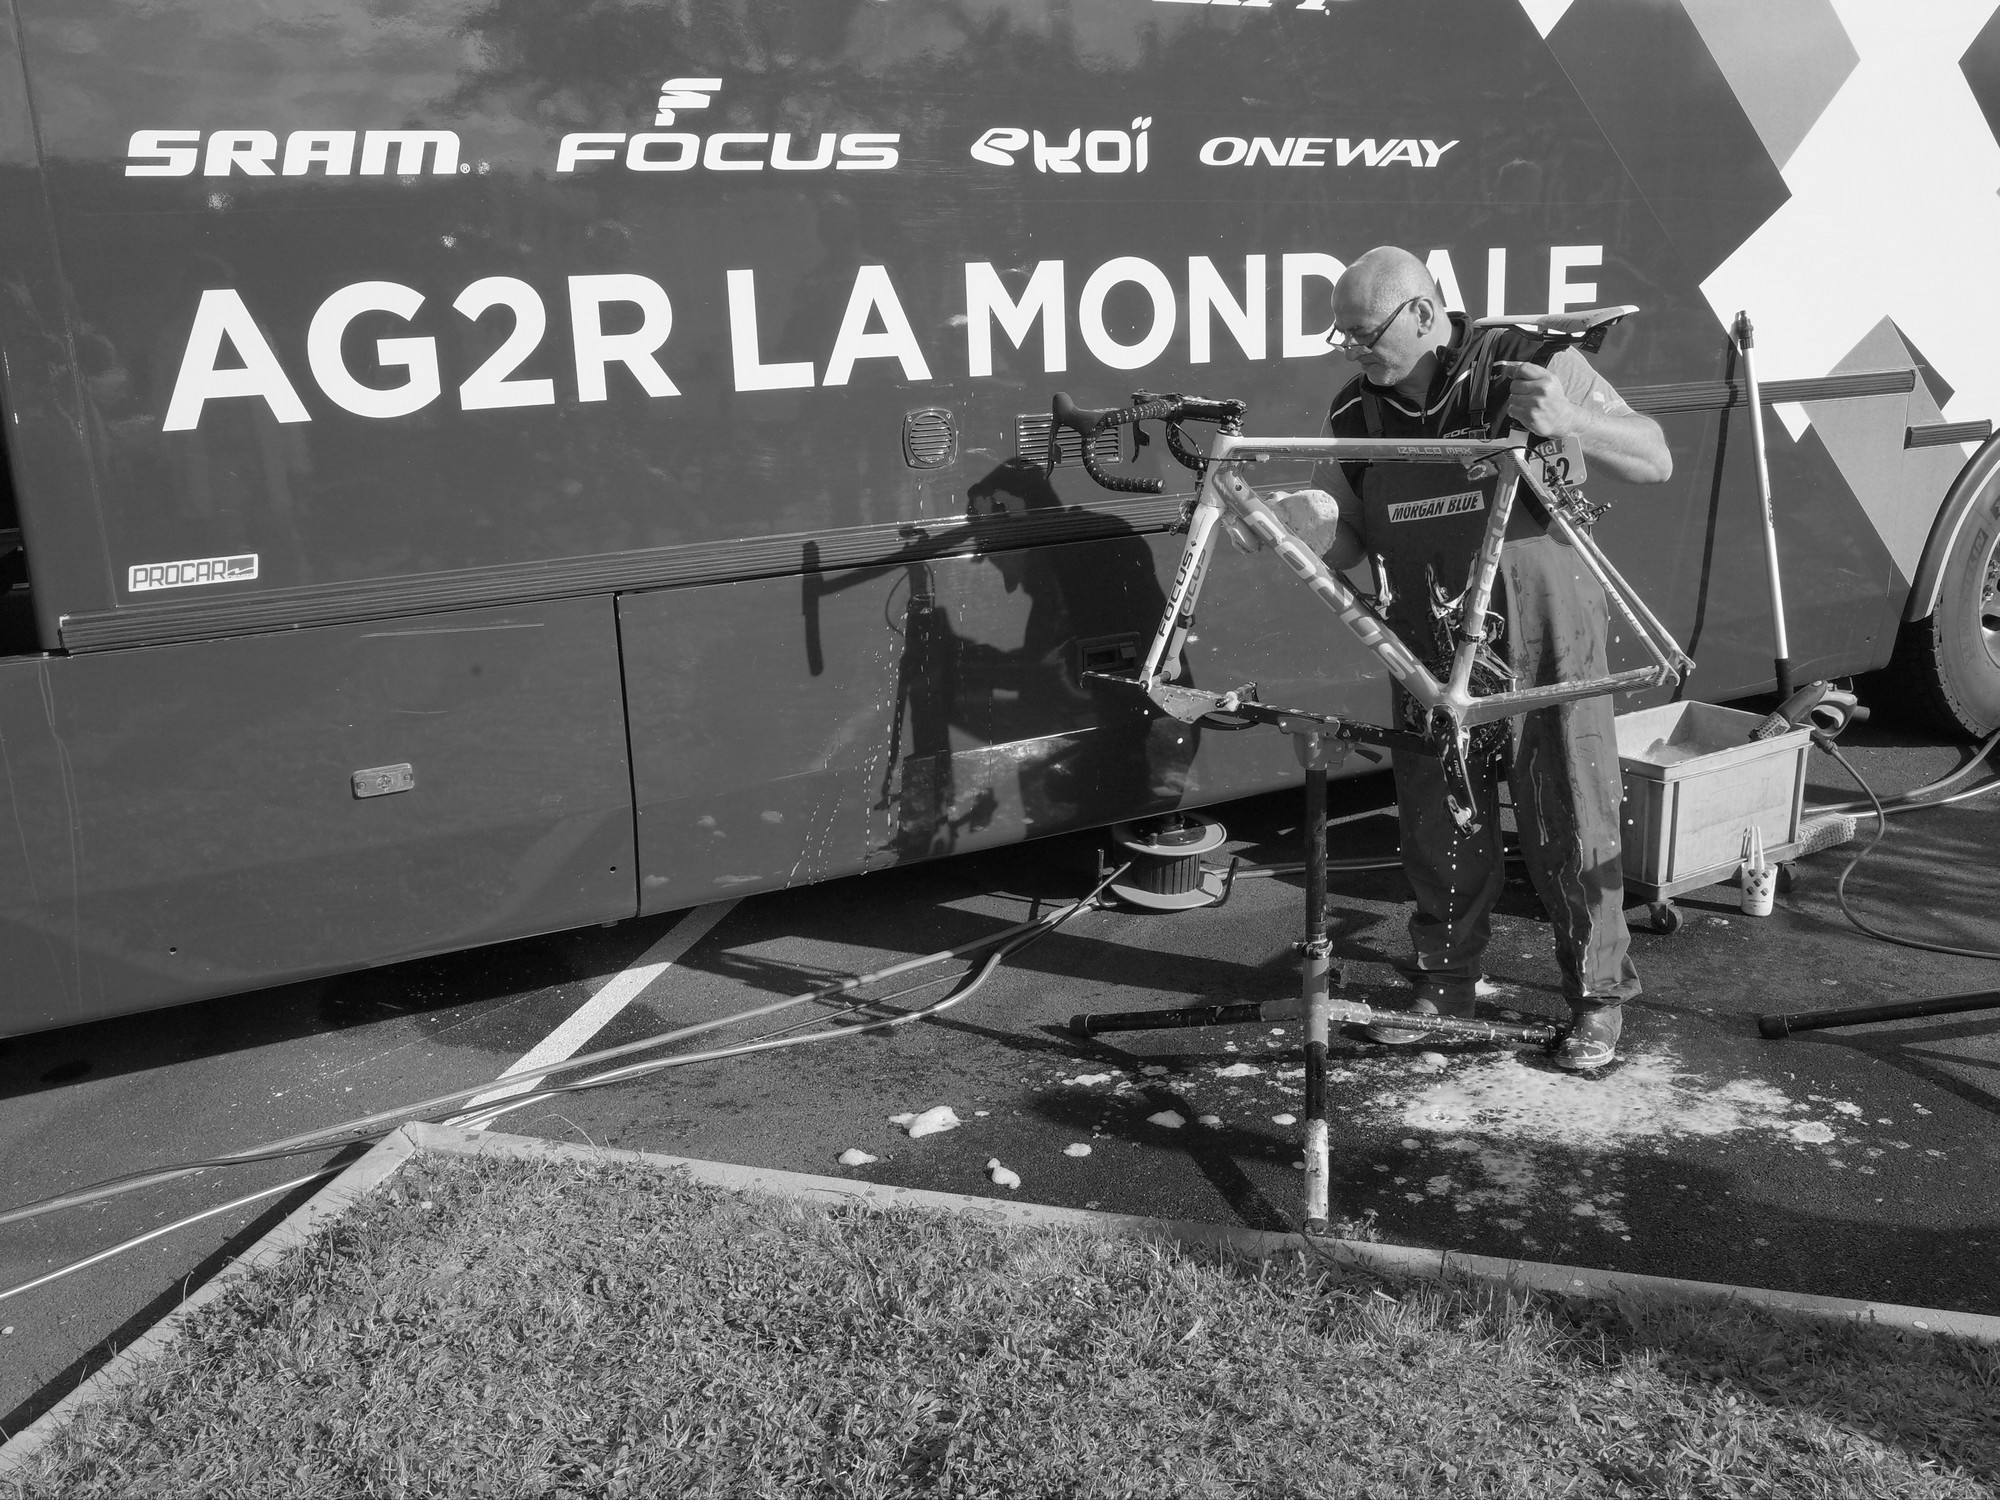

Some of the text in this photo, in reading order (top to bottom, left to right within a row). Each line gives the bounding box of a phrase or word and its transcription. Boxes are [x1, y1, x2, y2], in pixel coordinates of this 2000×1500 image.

[556, 132, 901, 172] FOCUS
[1199, 137, 1460, 168] ONEWAY
[162, 273, 682, 432] AG2R
[726, 265, 933, 392] LA
[1397, 446, 1473, 456] IZALCO MAX
[1391, 494, 1480, 521] MORGAN BLUE
[132, 559, 226, 589] PROCAR
[1158, 549, 1194, 637] FOCUS
[1181, 548, 1206, 615] OCUS
[1243, 510, 1416, 681] FOCUS
